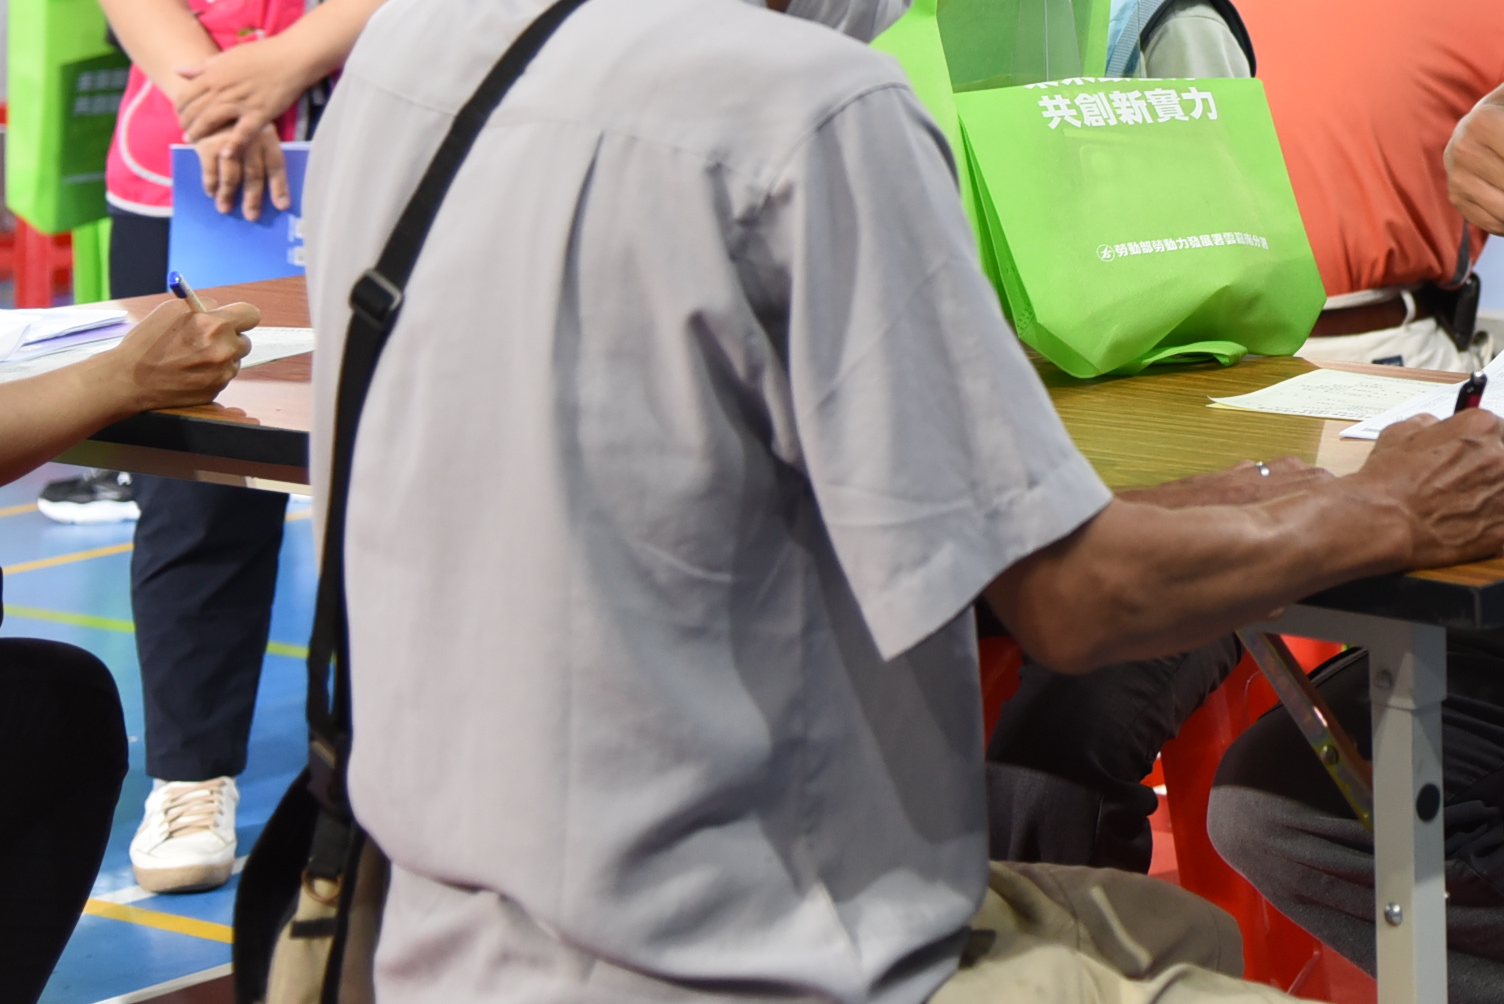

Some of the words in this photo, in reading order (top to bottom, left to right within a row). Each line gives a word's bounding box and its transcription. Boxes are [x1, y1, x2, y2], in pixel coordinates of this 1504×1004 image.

[1037, 86, 1218, 129] 共創新實力
